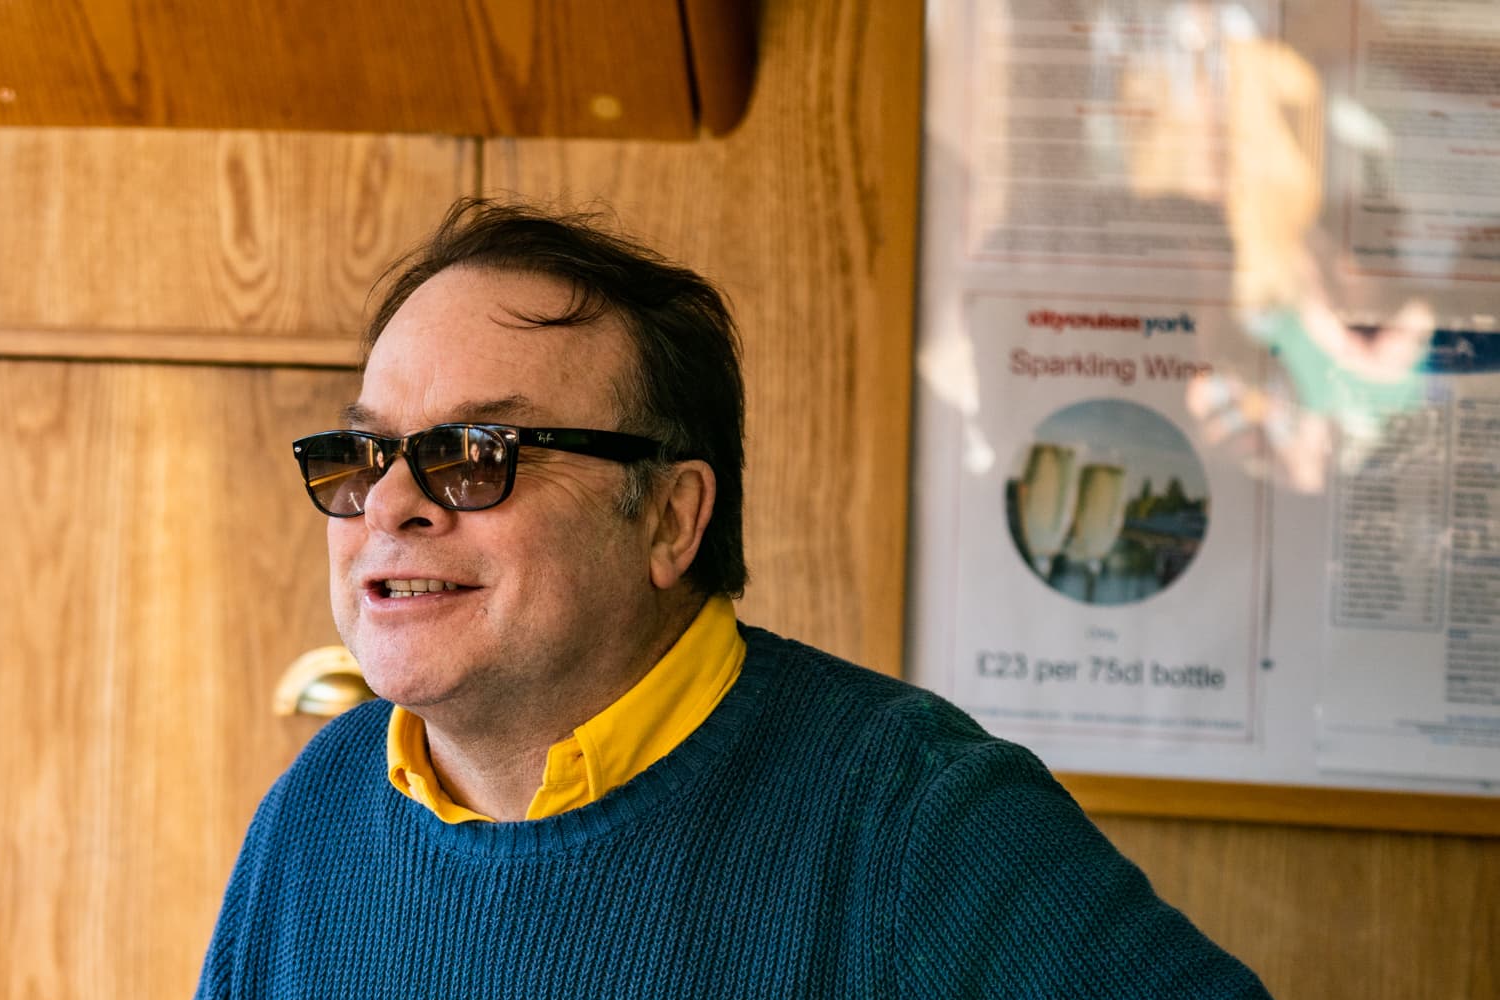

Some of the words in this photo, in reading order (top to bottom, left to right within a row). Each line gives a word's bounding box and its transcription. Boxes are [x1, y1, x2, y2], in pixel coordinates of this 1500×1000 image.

[1010, 348, 1136, 385] Sparkling
[977, 652, 1027, 678] £23
[1035, 659, 1078, 684] per
[1152, 662, 1226, 689] bottle
